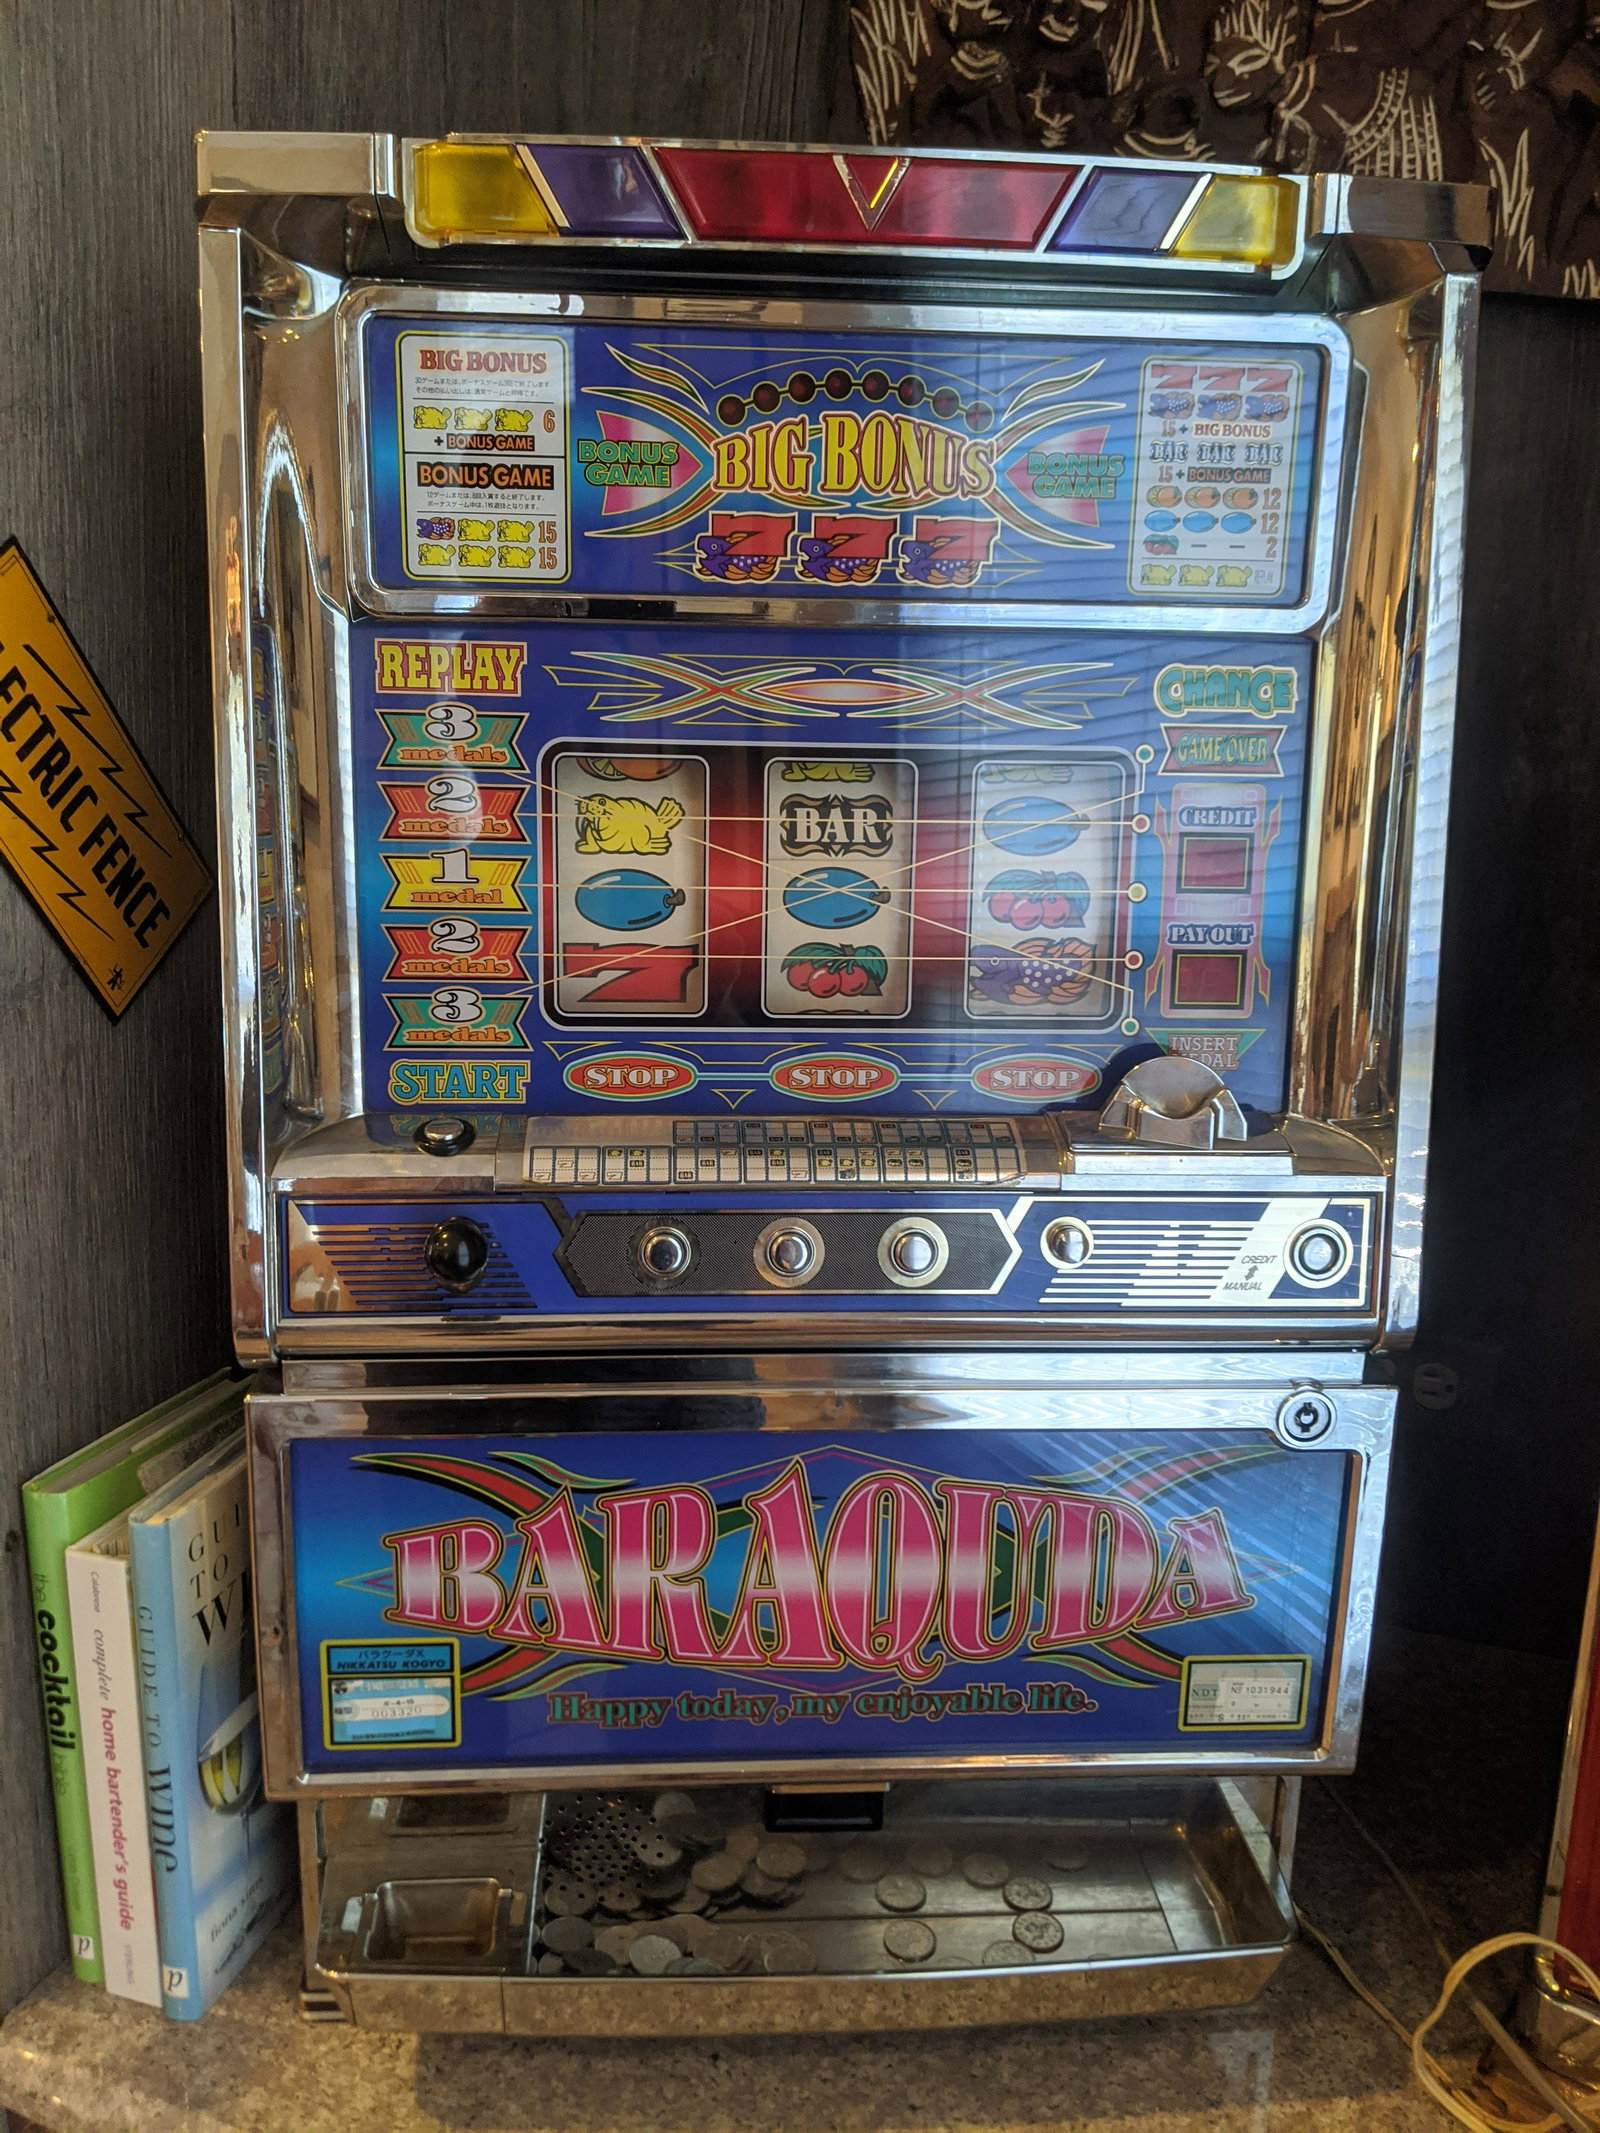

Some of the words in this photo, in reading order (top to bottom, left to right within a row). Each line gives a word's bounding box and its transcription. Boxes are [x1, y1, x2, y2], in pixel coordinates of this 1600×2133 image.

[420, 350, 462, 371] BIG
[466, 352, 547, 373] BONUS
[543, 411, 555, 432] 6
[1162, 422, 1176, 437] 15
[1193, 423, 1220, 437] BIG
[1222, 424, 1271, 438] BONUS
[447, 435, 494, 450] BONUS
[495, 437, 534, 450] GAME
[578, 441, 678, 464] BONUS
[1153, 443, 1186, 462] BAR
[1200, 444, 1233, 463] BAR
[1248, 445, 1281, 464] BAR
[713, 416, 813, 494] BIG
[819, 411, 997, 500] BONUS
[1027, 453, 1125, 477] BONUS
[419, 465, 488, 486] BONUS
[493, 468, 551, 487] GAME
[585, 464, 671, 486] GAME
[1158, 466, 1173, 482] 15
[1188, 469, 1231, 482] BONUS
[1234, 469, 1270, 483] GAME
[1033, 477, 1116, 498] GAME
[1263, 488, 1281, 510] 12
[538, 521, 557, 543] 15
[1260, 513, 1279, 534] 12
[538, 547, 557, 569] 15
[1266, 537, 1276, 558] 2
[379, 643, 523, 692] REPLAY
[1157, 667, 1294, 714] CHANCE
[425, 704, 478, 741] 3
[400, 745, 508, 763] medals
[1178, 735, 1222, 763] GAME
[1224, 736, 1268, 765] OVER
[0, 640, 98, 833] ECTRIC
[78, 813, 171, 949] FENCE
[427, 776, 478, 813] 2
[402, 817, 510, 835] medals
[794, 805, 882, 844] BAR
[1180, 807, 1257, 827] CREDIT
[431, 848, 480, 884] 1
[411, 888, 504, 904] medal
[430, 917, 480, 954] 2
[405, 957, 511, 974] medals
[431, 988, 483, 1023] 3
[406, 1027, 512, 1043] medals
[1171, 1037, 1238, 1051] INSERT
[392, 1062, 525, 1100] START
[585, 1067, 677, 1088] STOP
[790, 1067, 880, 1088] STOP
[991, 1068, 1082, 1089] STOP
[1241, 1255, 1278, 1264] CREDIT
[1223, 1282, 1262, 1291] MANUAL
[188, 1503, 241, 1563] GUI
[190, 1552, 228, 1600] TO
[382, 1458, 1257, 1680] BARAQUDA
[32, 1573, 49, 1603] the
[90, 1571, 101, 1614] Calabrese
[138, 1605, 159, 1698] GUIDE
[92, 1628, 113, 1702] complete
[337, 1660, 396, 1670] NIKKATSU
[402, 1659, 445, 1669] KOGYO
[37, 1607, 76, 1750] cocktail
[550, 1694, 671, 1727] Happy
[855, 1685, 1024, 1722] enjoyable
[1026, 1683, 1098, 1712] life.
[101, 1706, 117, 1762] home
[146, 1713, 162, 1748] TO
[106, 1765, 128, 1875] bartender's
[113, 1877, 135, 1931] guide
